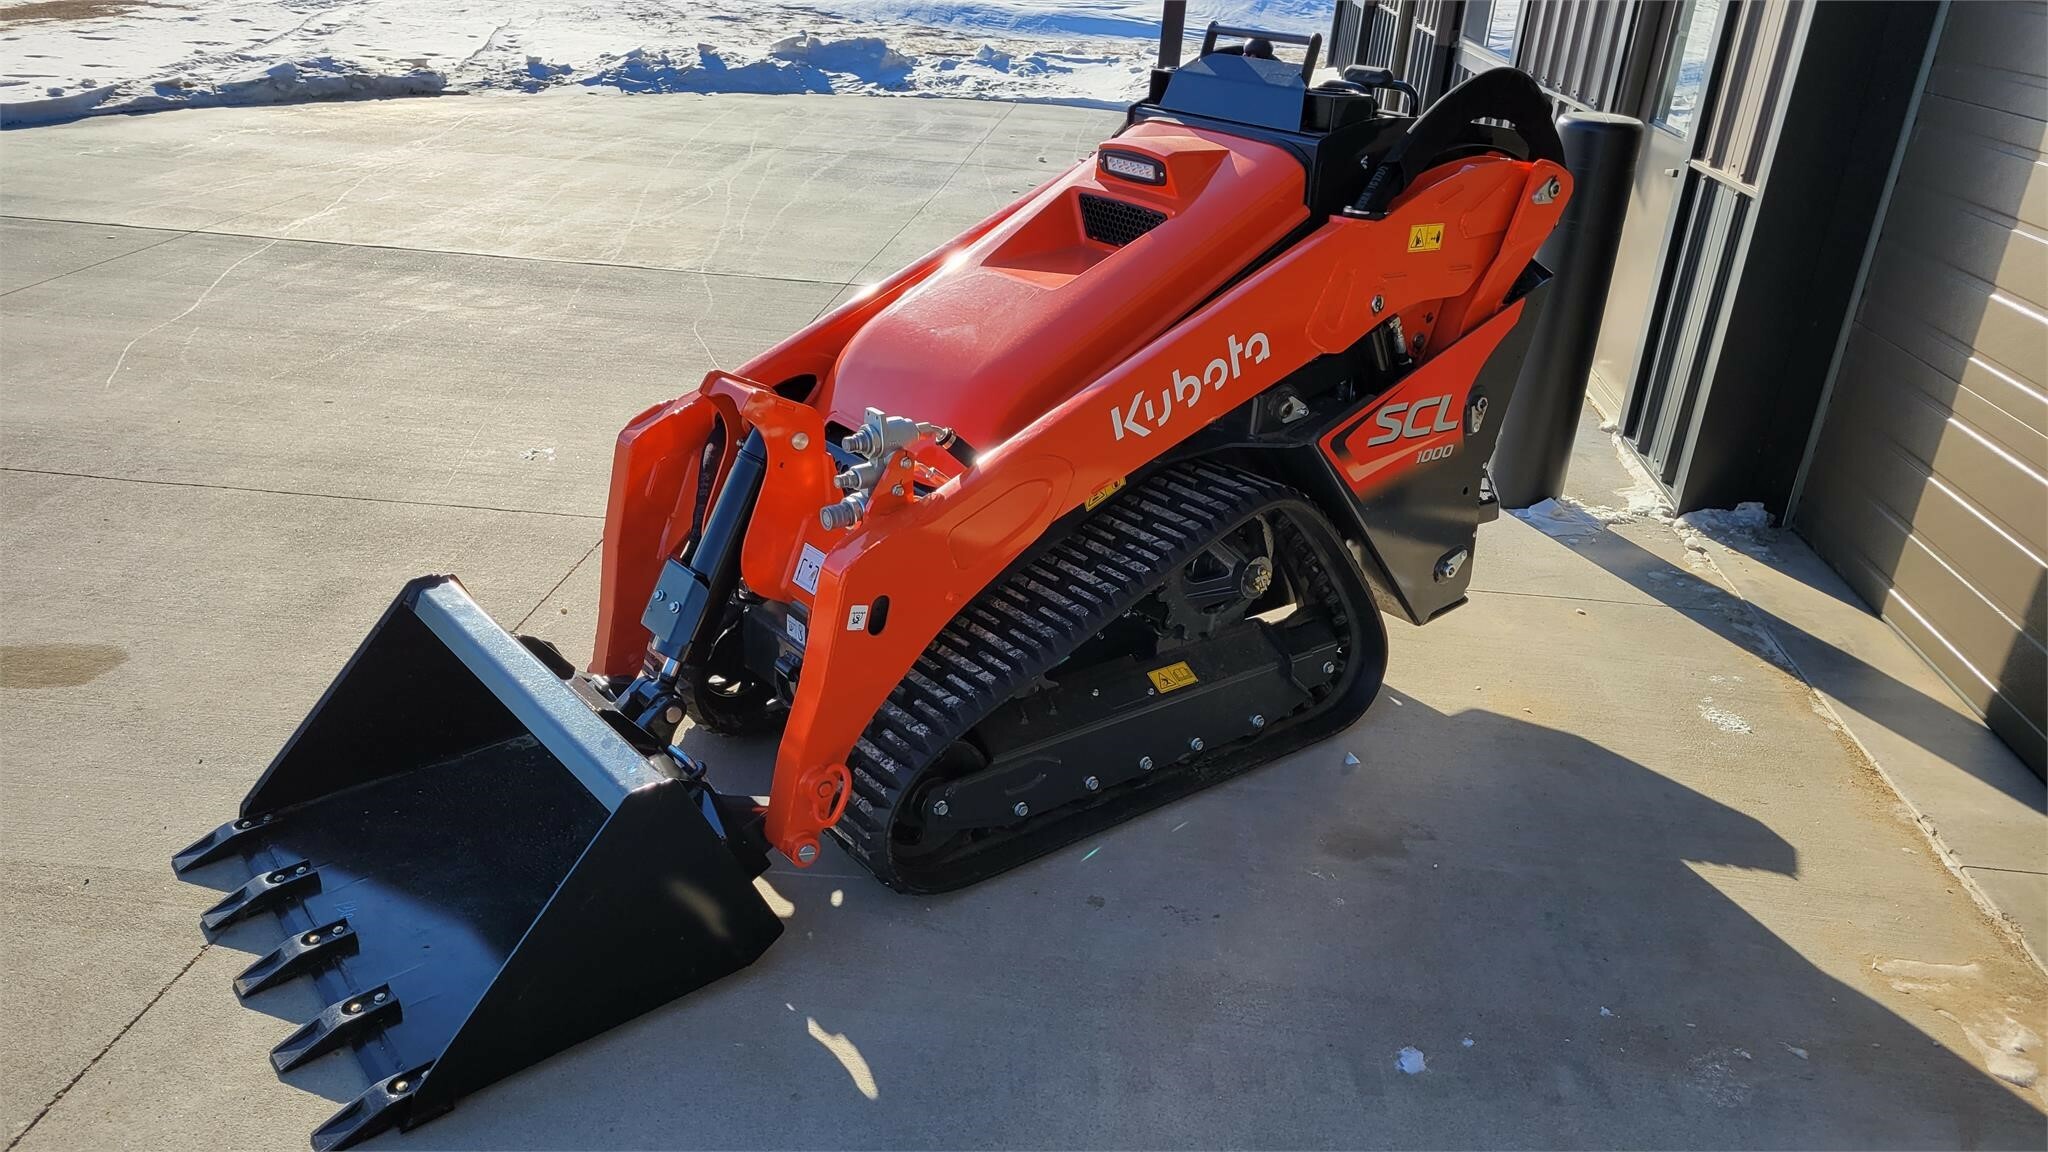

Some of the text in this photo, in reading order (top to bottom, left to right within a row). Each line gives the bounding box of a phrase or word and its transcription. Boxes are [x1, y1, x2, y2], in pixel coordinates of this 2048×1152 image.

[1110, 332, 1271, 441] Kubota
[1367, 394, 1459, 447] SCL
[1416, 444, 1455, 464] 1000
